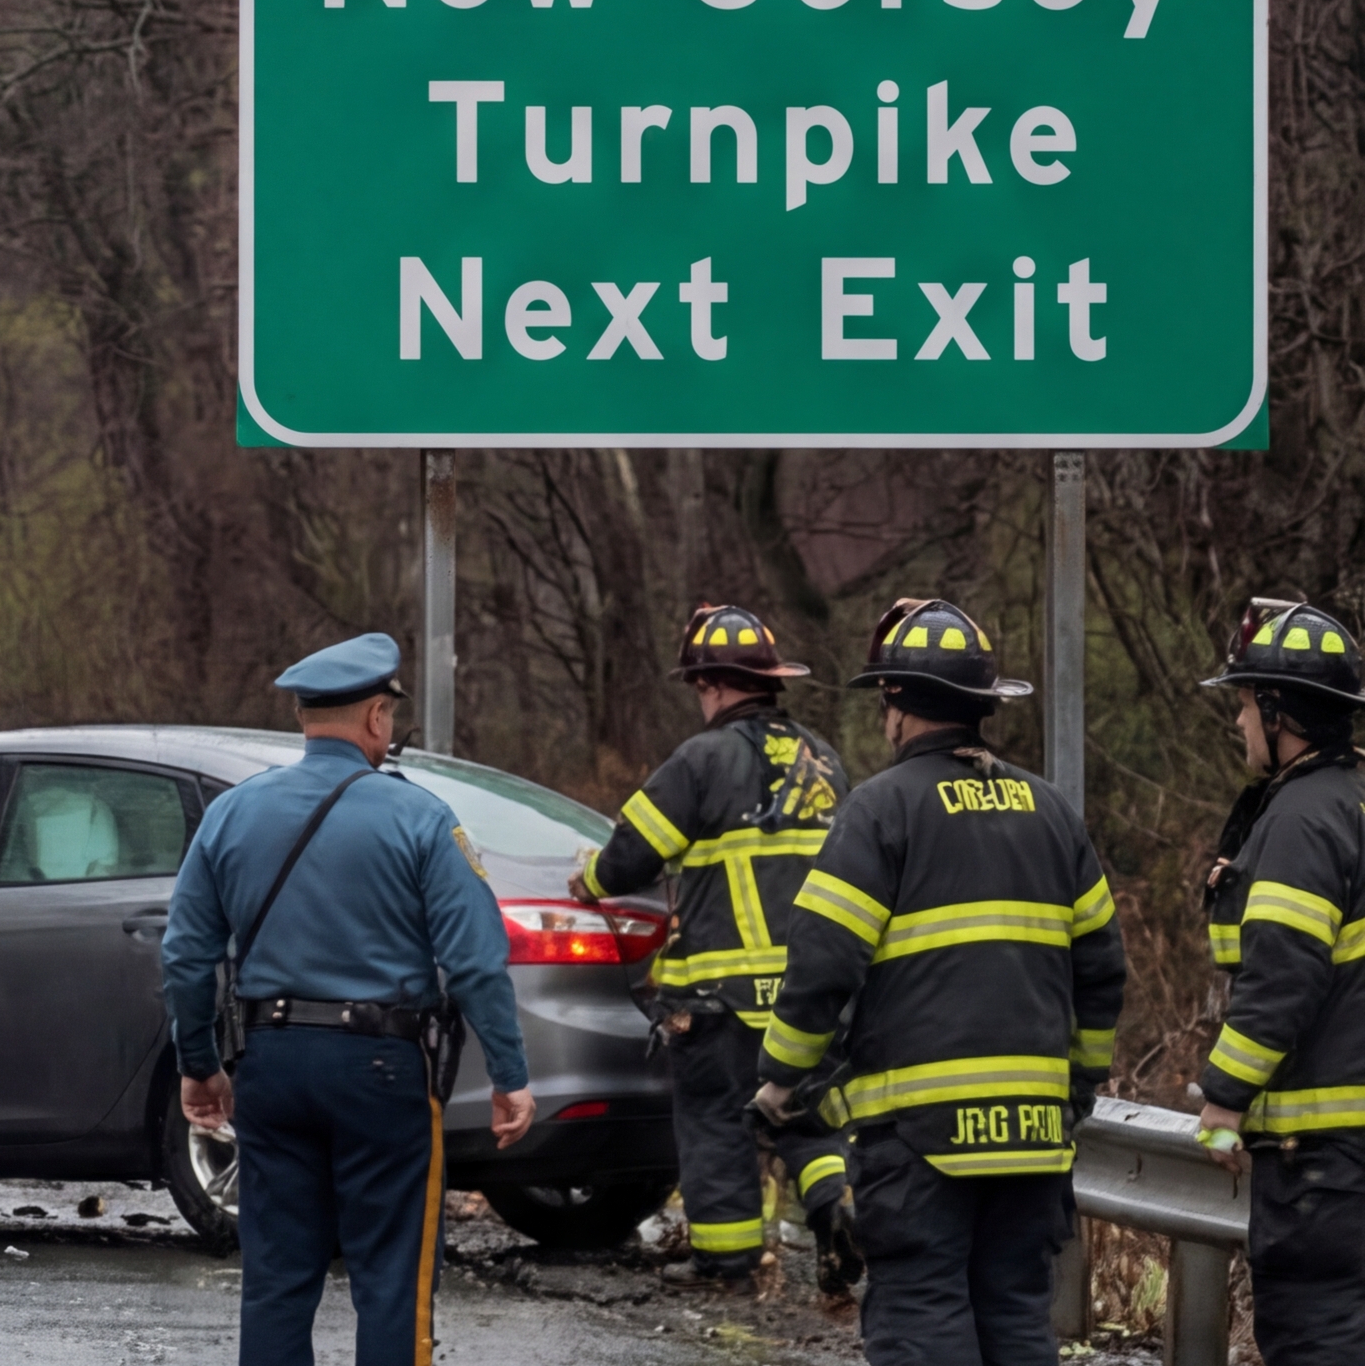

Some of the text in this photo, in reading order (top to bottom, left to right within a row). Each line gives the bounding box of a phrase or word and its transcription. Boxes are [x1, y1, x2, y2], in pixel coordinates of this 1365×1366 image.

[427, 78, 1078, 213] Turnpike
[398, 254, 1108, 363] Next Exit
